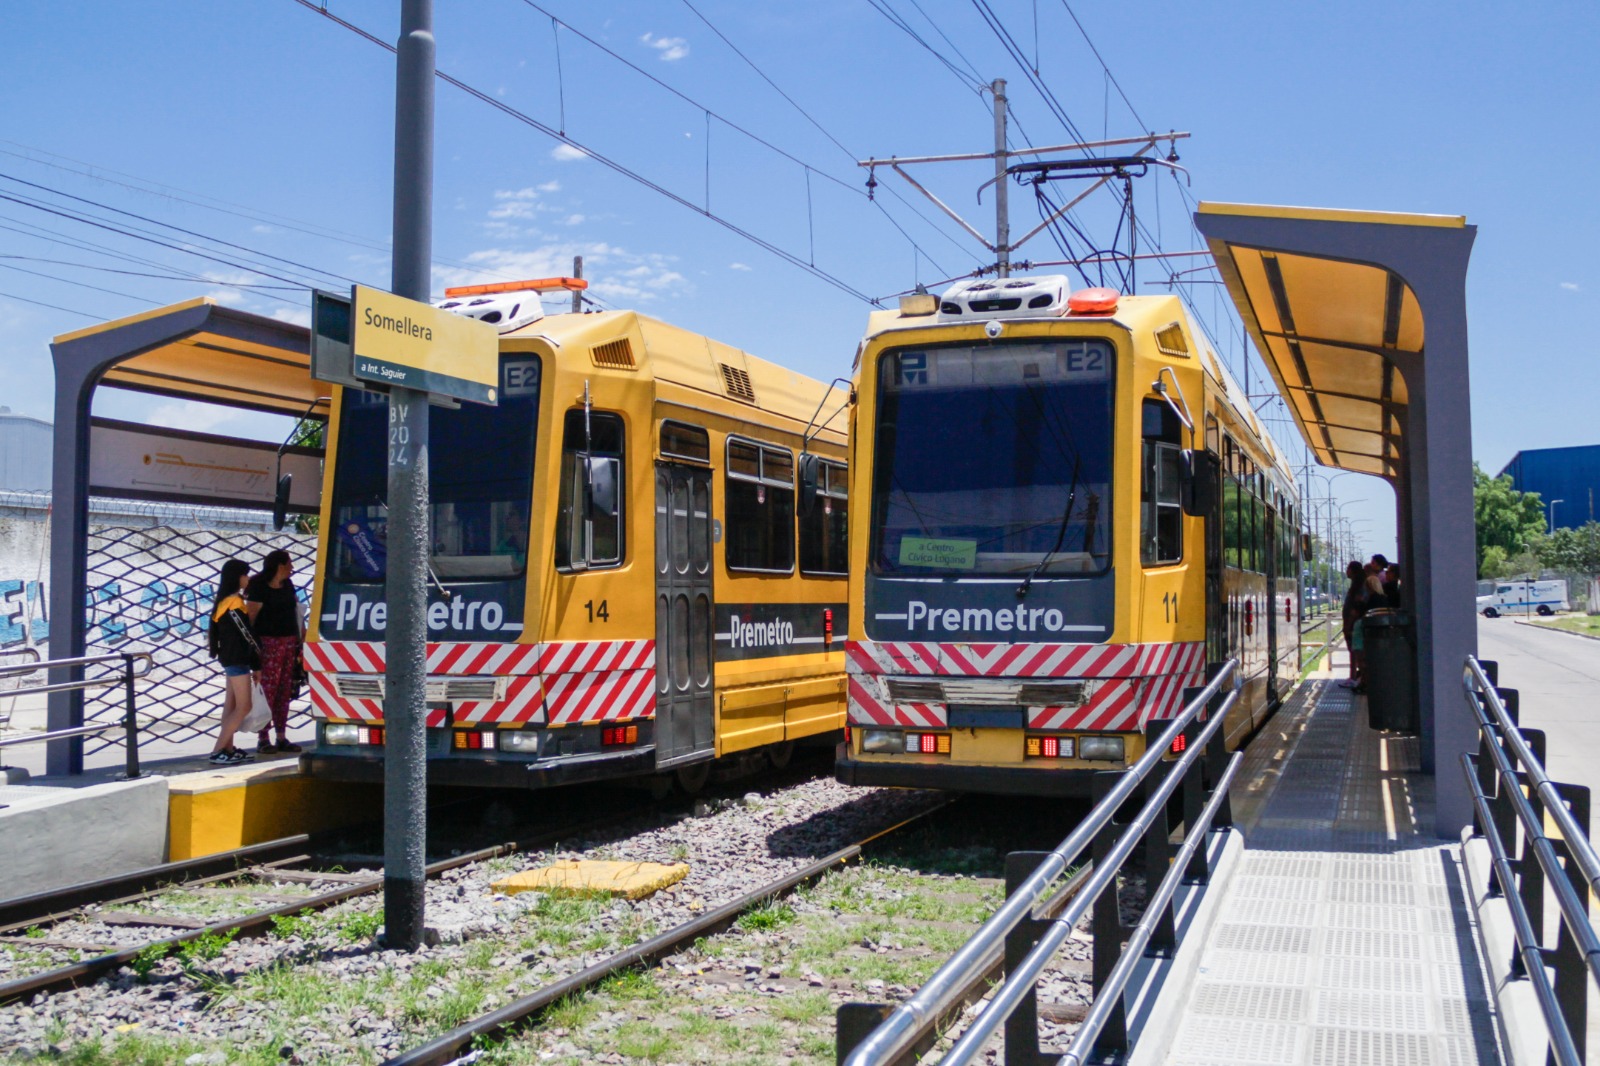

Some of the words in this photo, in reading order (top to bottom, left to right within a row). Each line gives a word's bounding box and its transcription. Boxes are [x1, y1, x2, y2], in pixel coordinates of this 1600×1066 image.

[364, 307, 432, 341] Somellera
[1066, 349, 1103, 371] E2
[361, 363, 367, 371] a
[380, 366, 407, 380] Saguier
[507, 367, 537, 388] E2
[390, 404, 409, 423] BV
[390, 426, 410, 445] 20
[389, 447, 408, 466] 24
[926, 543, 955, 552] Centro
[934, 554, 966, 566] Lugano
[336, 593, 504, 631] Preetro
[584, 600, 609, 623] 14
[907, 600, 1064, 632] Premetro
[1162, 592, 1178, 624] 11
[731, 615, 794, 648] Premetro
